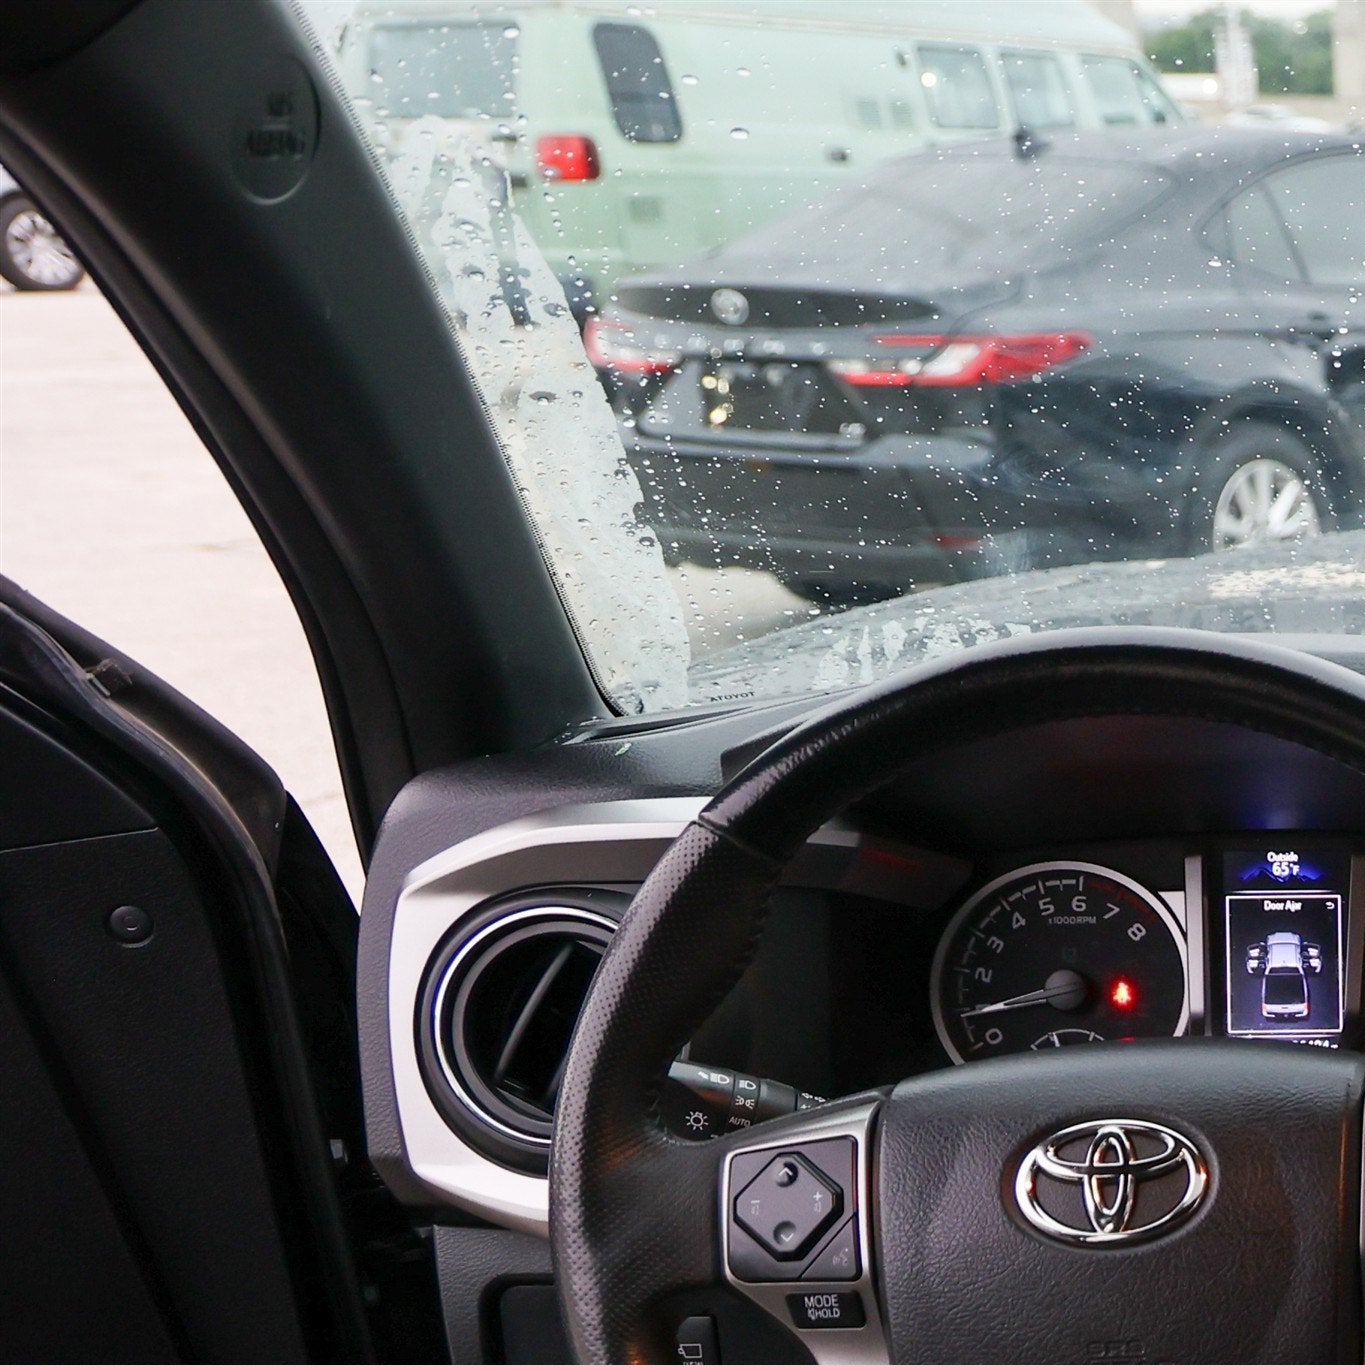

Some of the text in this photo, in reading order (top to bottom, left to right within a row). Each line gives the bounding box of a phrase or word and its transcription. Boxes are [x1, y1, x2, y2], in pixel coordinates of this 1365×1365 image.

[1267, 851, 1298, 862] Outside
[1038, 898, 1054, 916] 5
[1071, 896, 1087, 911] 6
[1103, 902, 1120, 920] 7
[1264, 900, 1302, 912] Door Ajar
[1012, 912, 1026, 929] 4
[1127, 922, 1147, 941] 8
[987, 937, 1004, 953] 3
[975, 967, 993, 983] 2
[985, 1028, 1003, 1045] 0
[804, 1295, 839, 1307] MODE
[816, 1308, 840, 1319] HOLD
